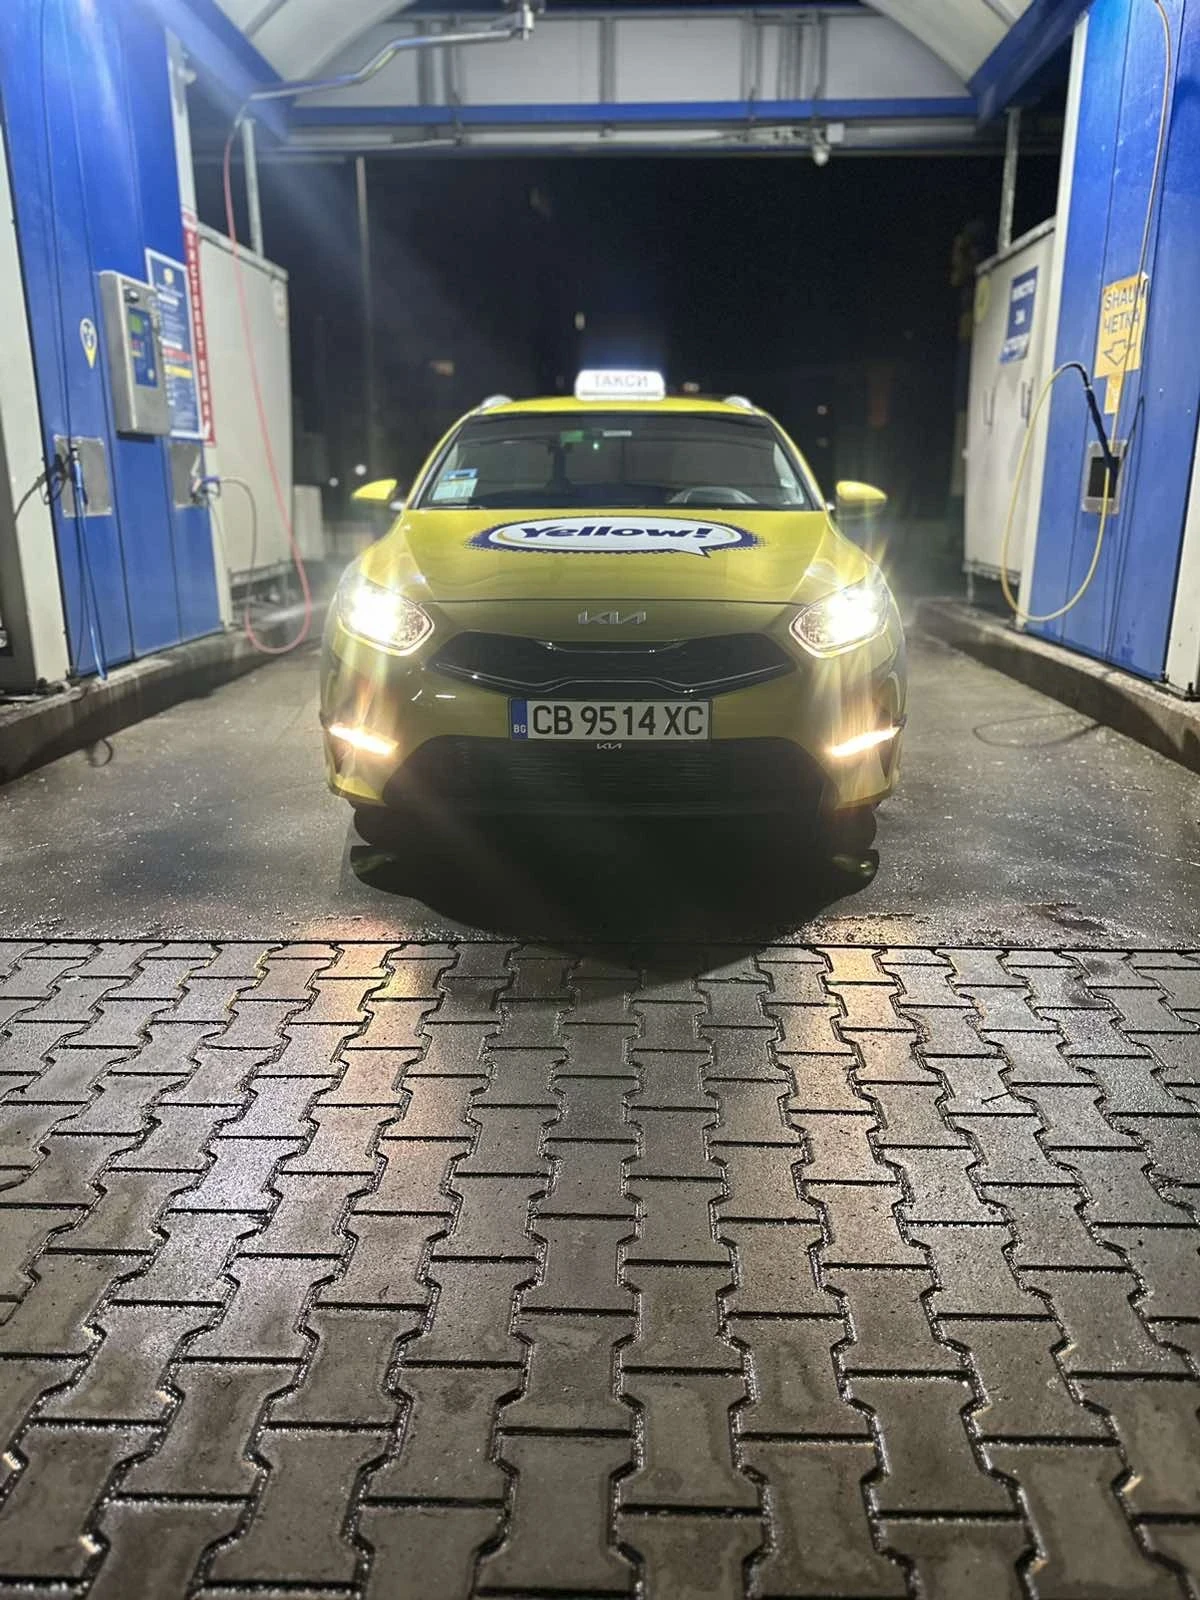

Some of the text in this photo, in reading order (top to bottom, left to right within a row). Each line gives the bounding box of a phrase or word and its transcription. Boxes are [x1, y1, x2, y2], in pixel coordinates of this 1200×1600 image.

[595, 374, 649, 388] ТАКСИ
[520, 525, 713, 539] Yellow!
[577, 609, 647, 625] KIA
[533, 705, 704, 736] CB 9514 XC
[513, 723, 527, 734] BG
